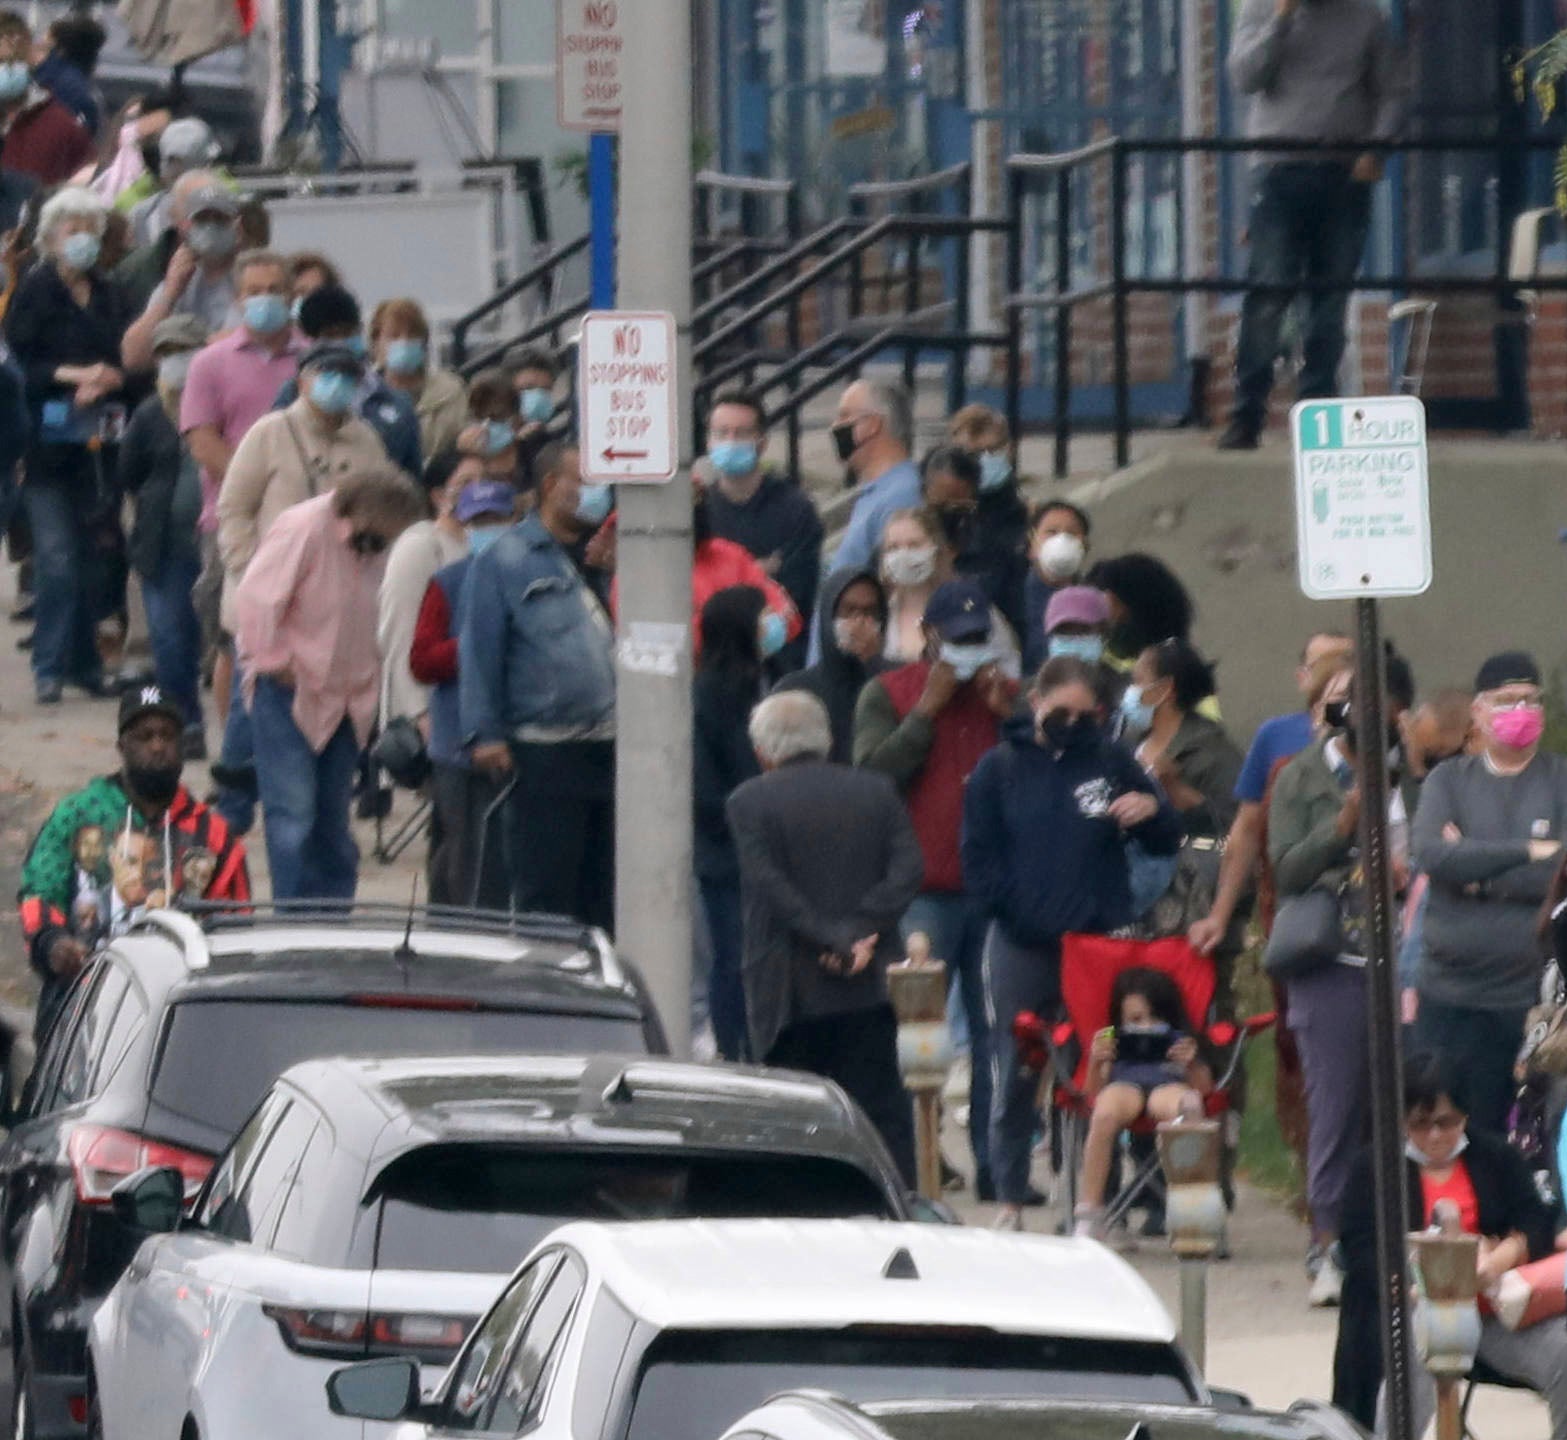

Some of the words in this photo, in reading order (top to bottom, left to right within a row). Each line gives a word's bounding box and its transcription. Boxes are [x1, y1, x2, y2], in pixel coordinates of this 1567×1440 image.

[614, 327, 641, 356] NO
[590, 363, 667, 385] STOPPING
[610, 389, 646, 411] BUS
[606, 416, 652, 438] STOP
[1314, 409, 1329, 446] 1
[1350, 420, 1415, 440] HOUR
[1309, 451, 1415, 474] PARKING
